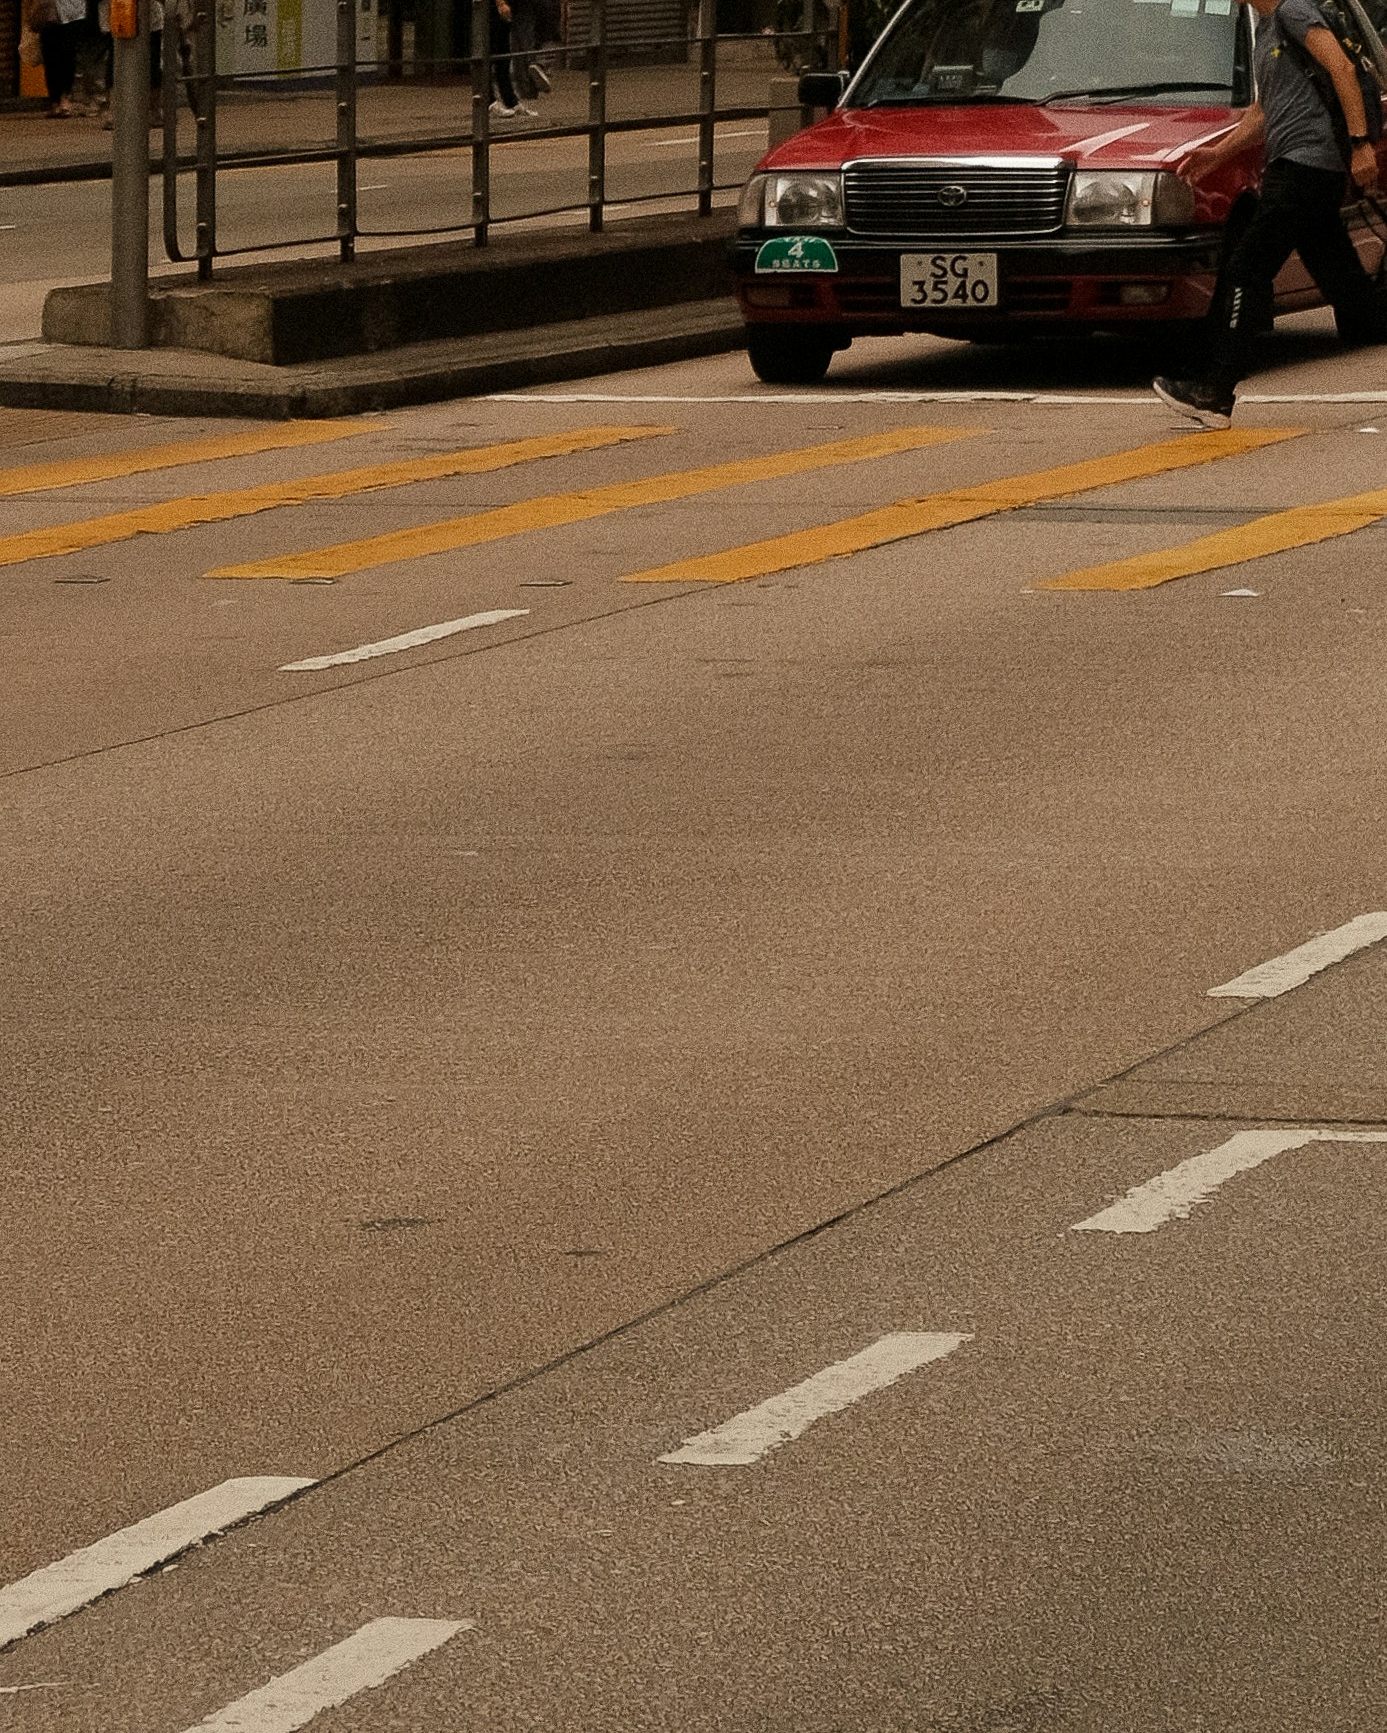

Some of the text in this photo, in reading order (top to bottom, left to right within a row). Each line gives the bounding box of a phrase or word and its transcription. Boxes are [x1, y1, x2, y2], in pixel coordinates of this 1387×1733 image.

[785, 241, 804, 259] 4
[772, 258, 822, 270] SEATS
[930, 255, 968, 280] SG
[910, 280, 990, 304] 3540
